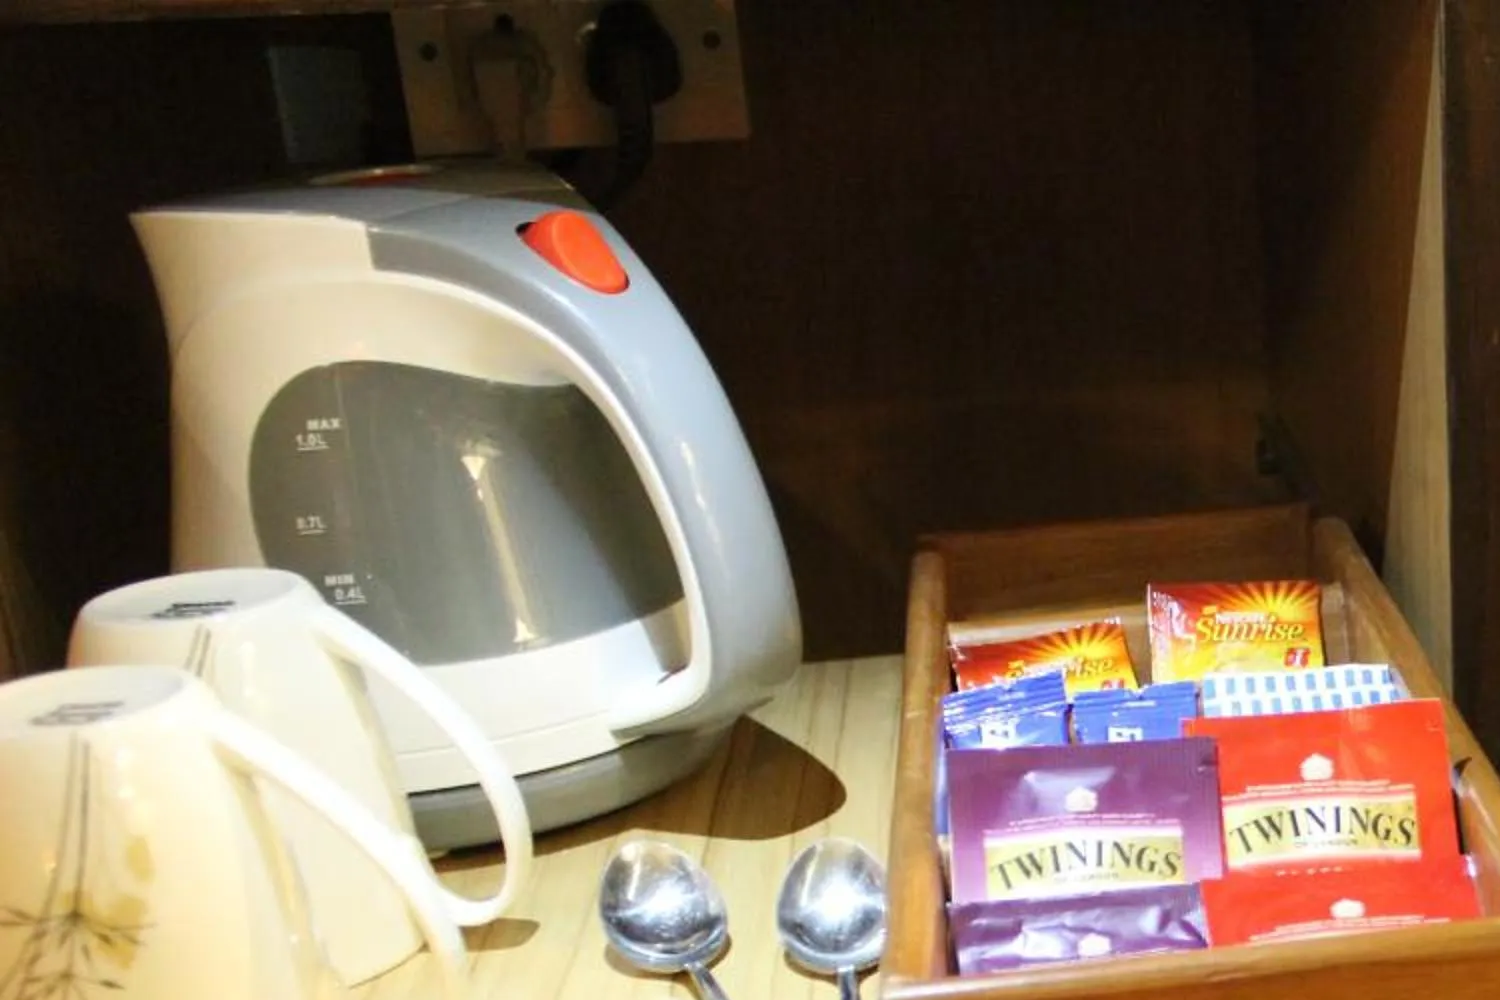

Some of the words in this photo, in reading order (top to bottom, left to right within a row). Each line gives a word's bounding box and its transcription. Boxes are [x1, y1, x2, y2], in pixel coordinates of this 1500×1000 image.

[306, 418, 341, 431] MAX
[1196, 612, 1306, 643] Sunrise
[1229, 804, 1416, 854] TWININGS
[990, 839, 1182, 891] TWININGS
